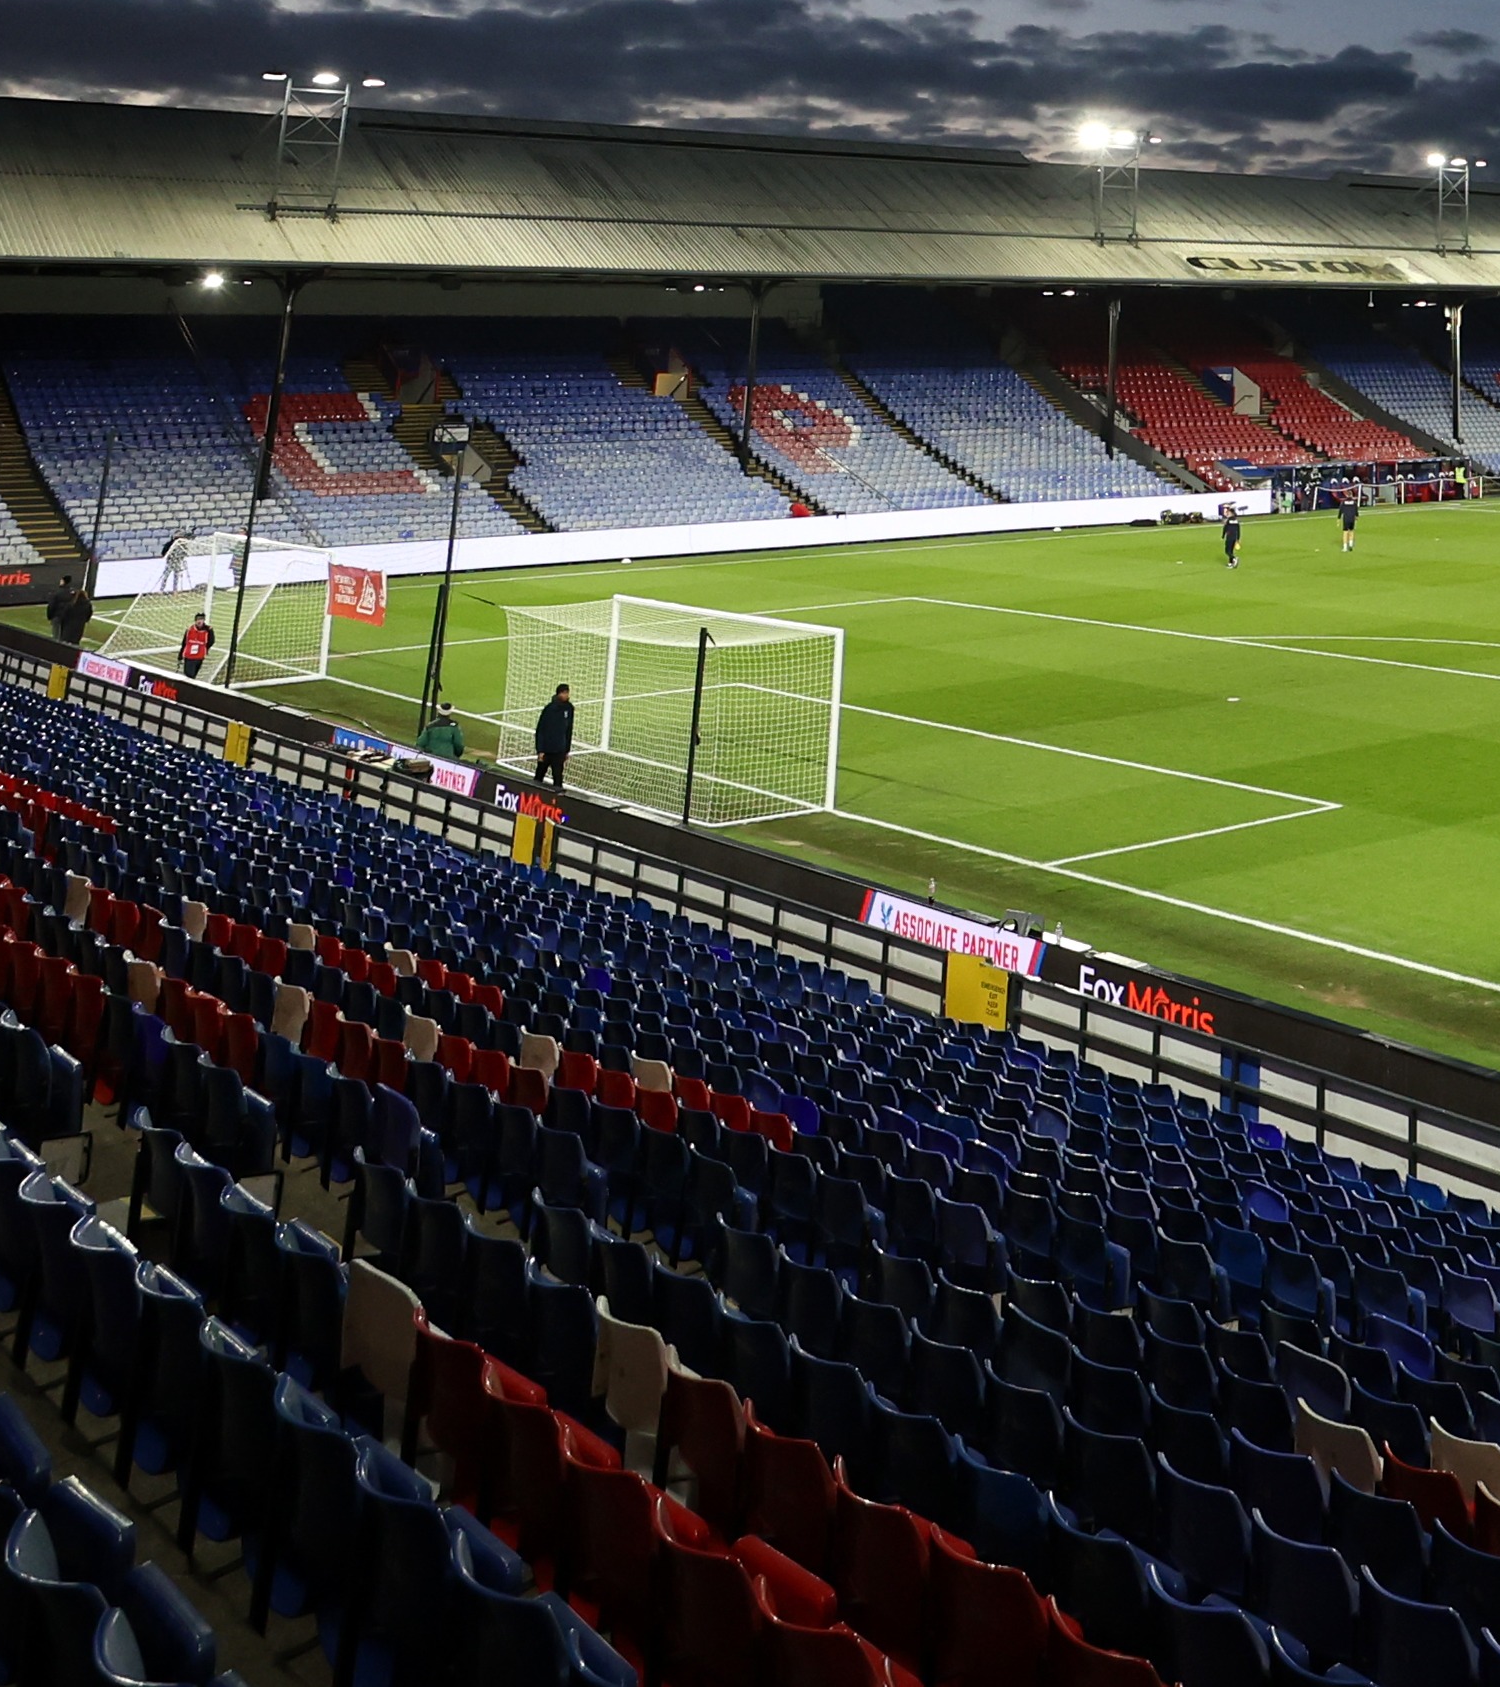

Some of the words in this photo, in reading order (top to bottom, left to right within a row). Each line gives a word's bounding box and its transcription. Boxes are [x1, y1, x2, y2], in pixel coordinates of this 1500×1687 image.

[436, 768, 466, 794] PARTNER
[894, 910, 958, 952] ASSOCIATE
[962, 932, 1019, 972] PARTNER
